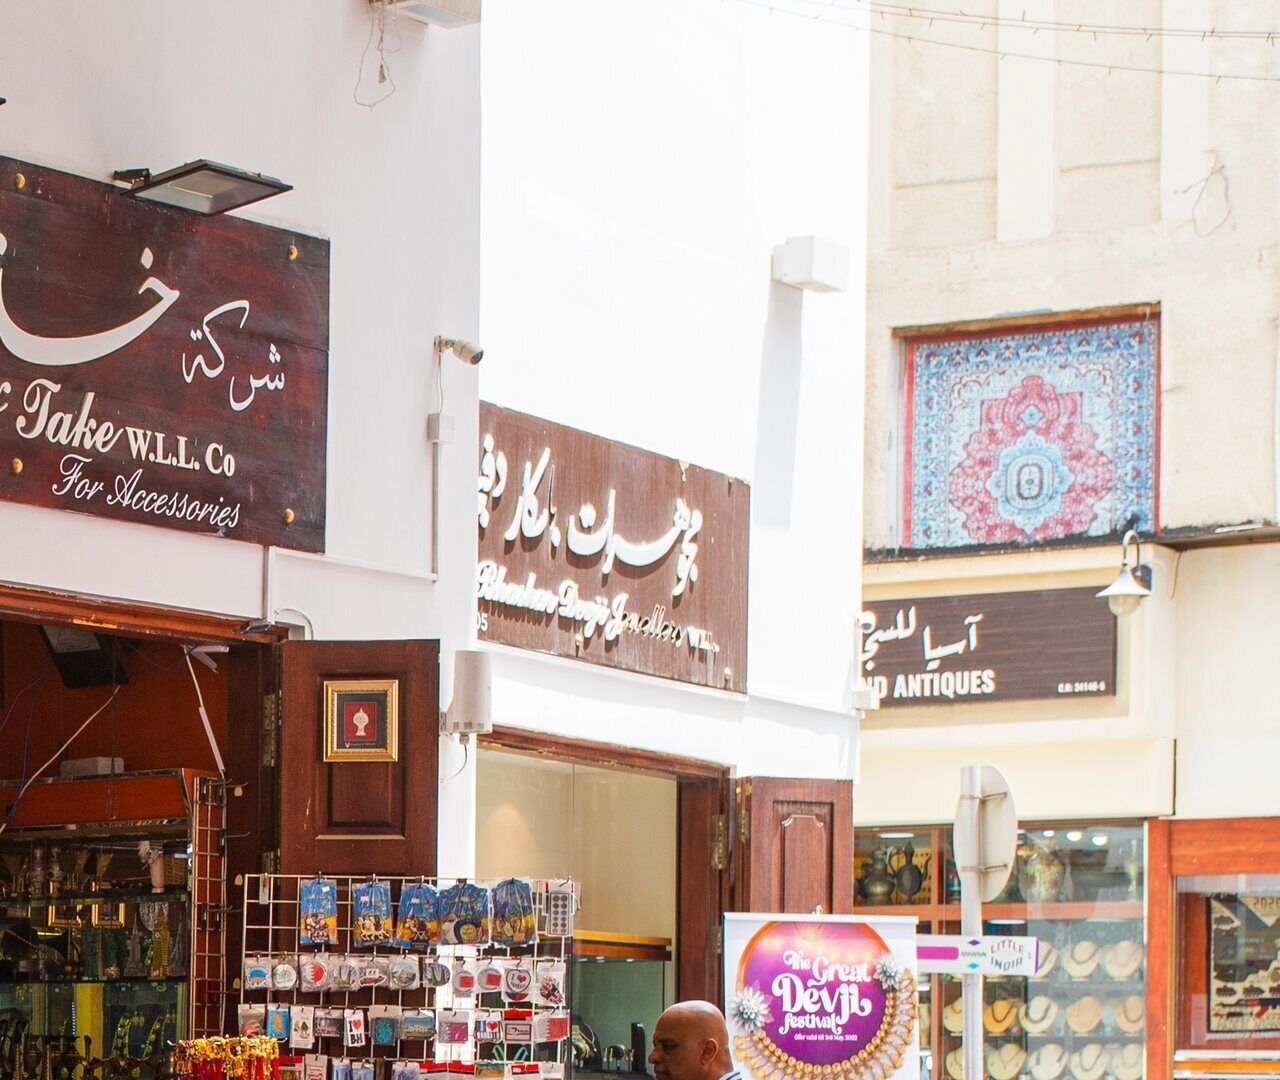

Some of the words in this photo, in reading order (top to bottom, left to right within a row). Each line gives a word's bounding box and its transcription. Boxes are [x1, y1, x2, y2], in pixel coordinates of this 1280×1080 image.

[182, 300, 285, 411] شركة
[16, 378, 126, 453] Take
[205, 443, 236, 477] Co
[52, 454, 104, 501] For
[106, 468, 240, 528] Accessories
[604, 592, 685, 648] Jewellery
[923, 613, 983, 671] آسيا
[893, 668, 996, 699] ANTIQUES
[783, 949, 812, 970] The
[807, 957, 872, 987] Great
[990, 939, 1024, 954] LITTLE
[990, 957, 1023, 971] INDIA
[778, 1012, 843, 1035] festival
